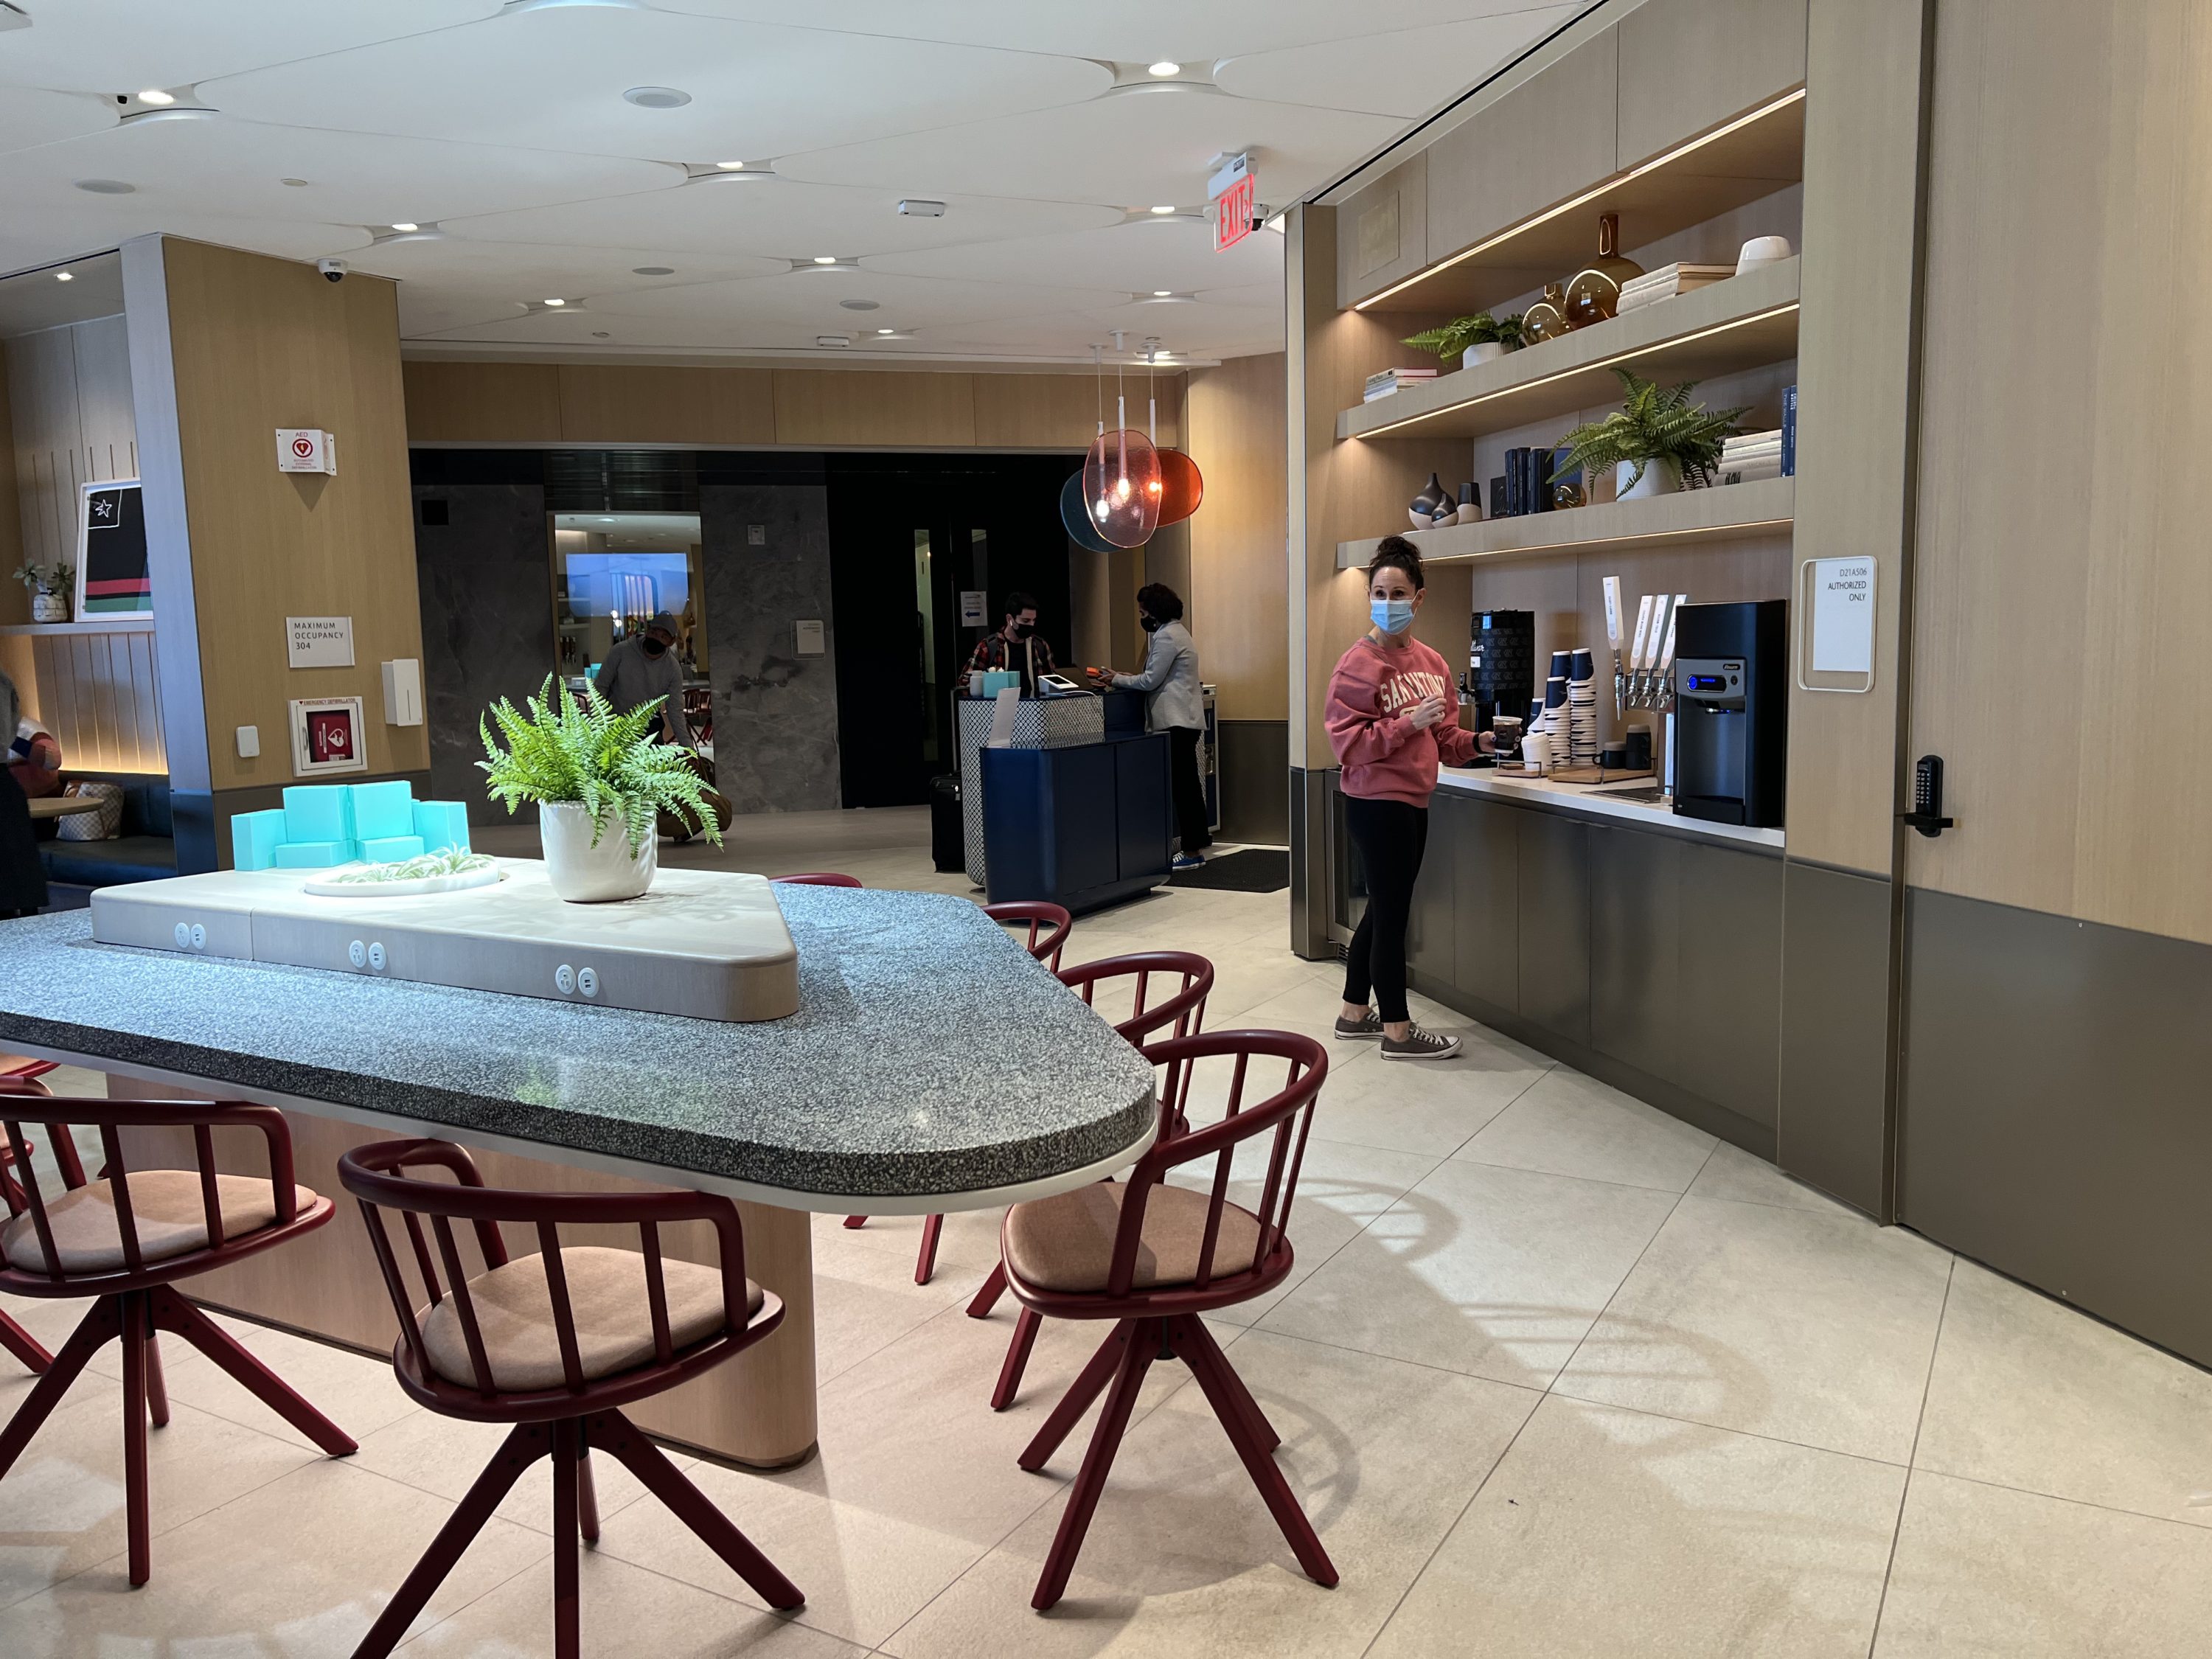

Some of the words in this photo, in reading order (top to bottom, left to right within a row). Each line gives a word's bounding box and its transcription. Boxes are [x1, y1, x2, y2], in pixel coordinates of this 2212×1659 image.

[1220, 184, 1245, 243] EXIT
[1839, 568, 1868, 577] D21A506
[1828, 580, 1867, 590] AUTHORIZED
[1848, 593, 1866, 601] ONLY
[1380, 675, 1412, 713] SAN
